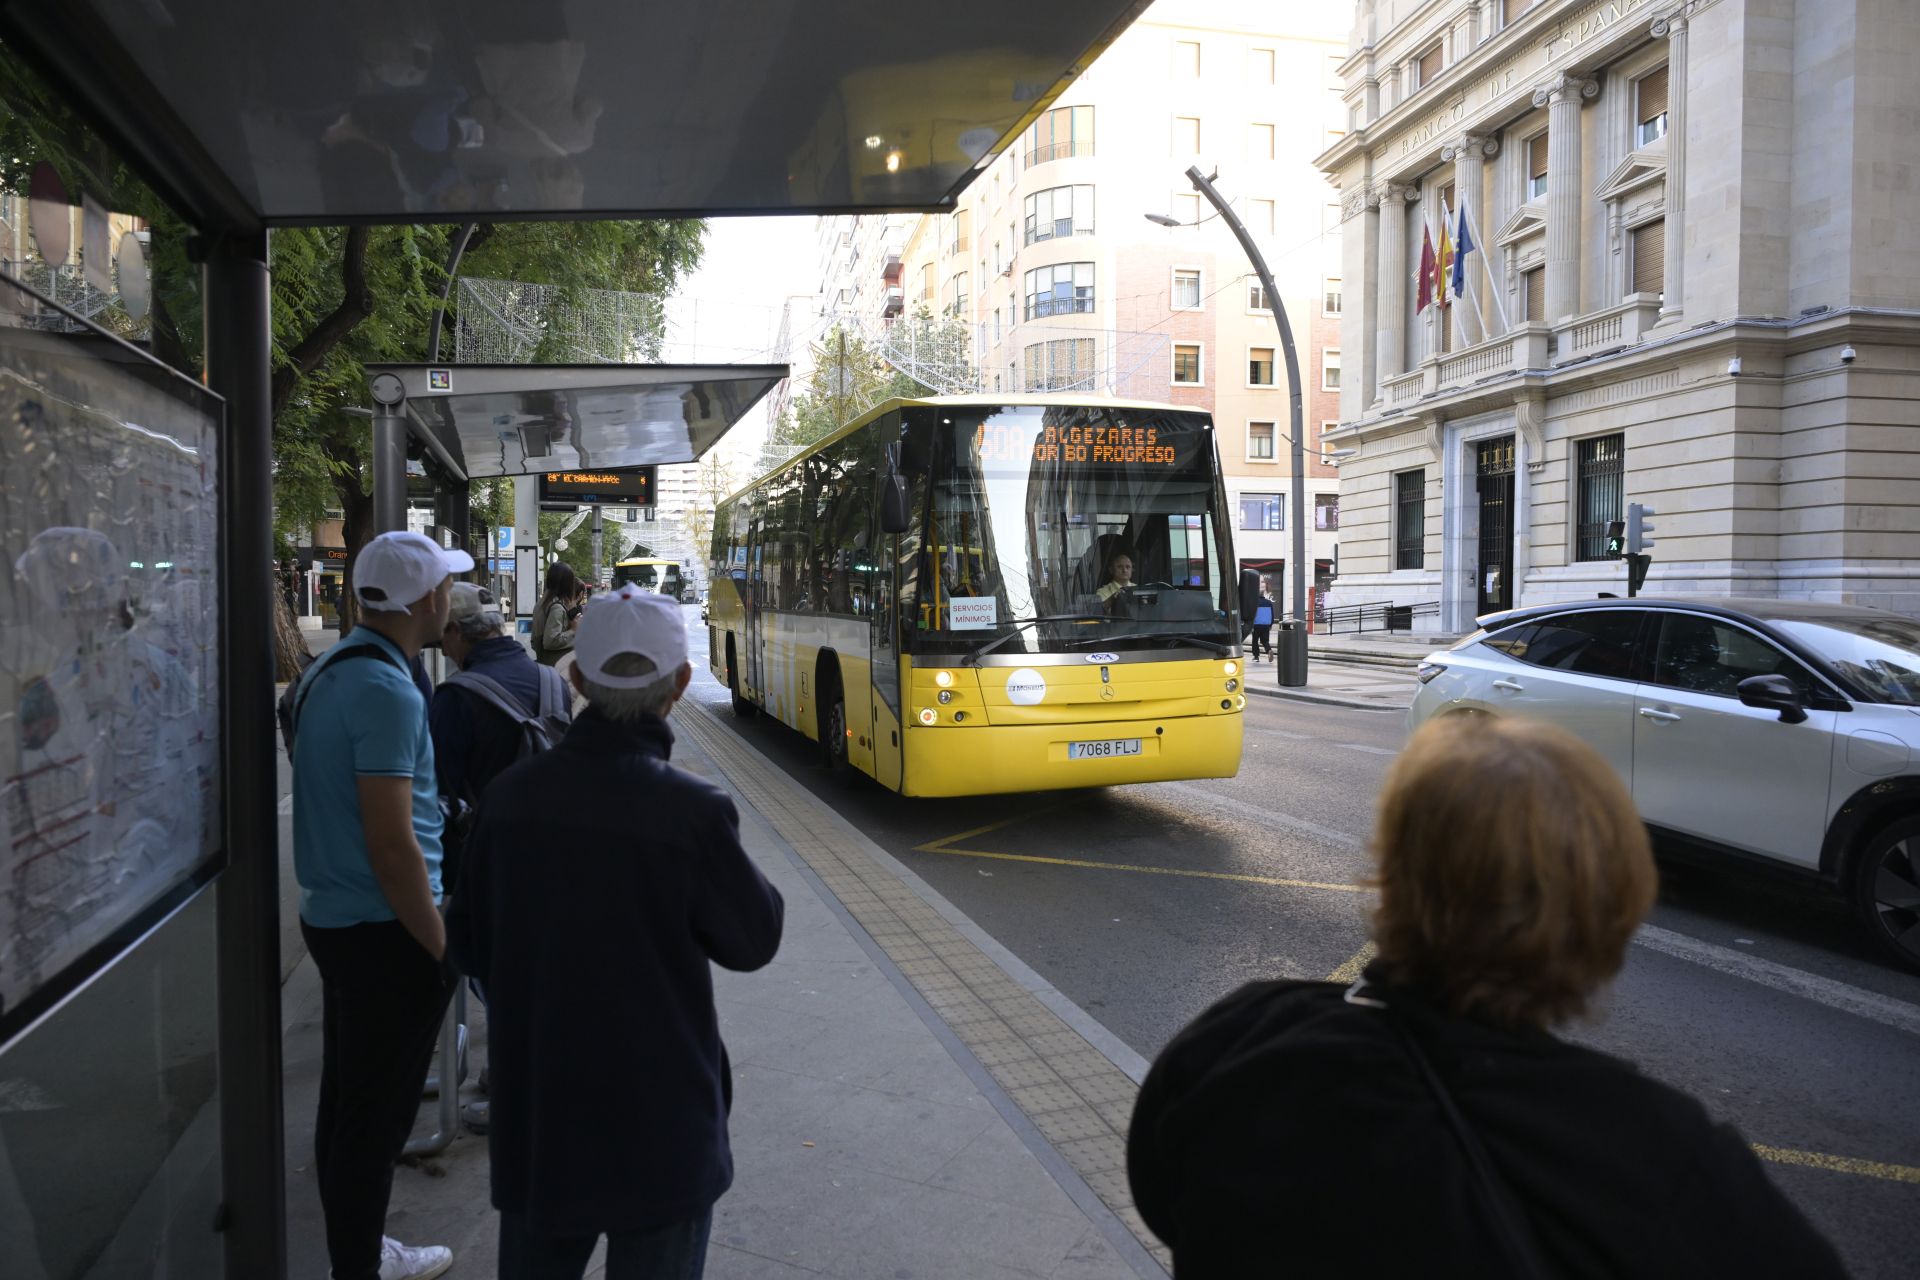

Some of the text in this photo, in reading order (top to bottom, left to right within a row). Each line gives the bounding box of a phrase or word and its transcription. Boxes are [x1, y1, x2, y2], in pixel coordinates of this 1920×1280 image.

[1401, 104, 1465, 155] BANCO
[1489, 67, 1515, 99] DE
[1044, 425, 1158, 445] ALGEZARES
[1093, 446, 1176, 464] PROGRESO
[327, 550, 348, 559] Oran
[952, 604, 993, 612] SERVICIOS
[955, 614, 992, 623] MÍNIMOS
[1078, 740, 1139, 757] 7068 FLJ
